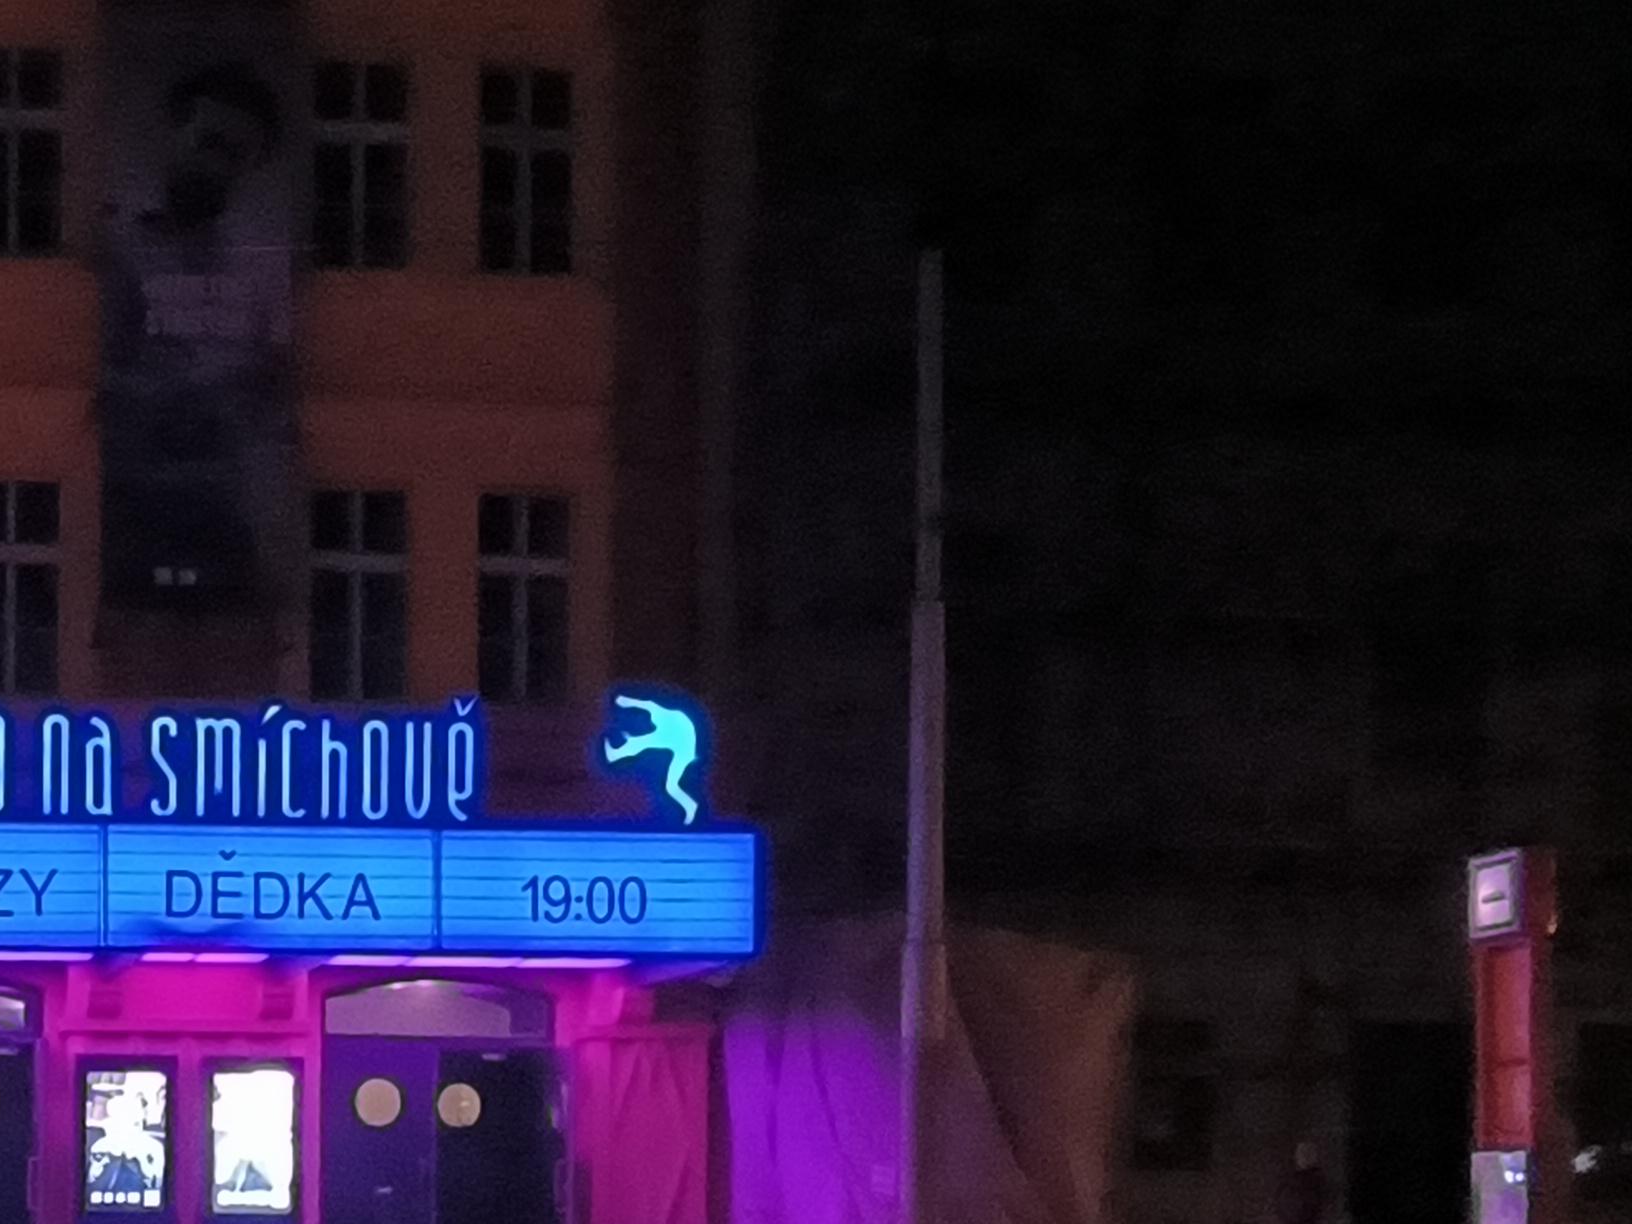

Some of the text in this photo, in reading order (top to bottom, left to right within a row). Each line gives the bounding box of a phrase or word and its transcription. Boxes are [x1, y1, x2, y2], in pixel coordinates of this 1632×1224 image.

[42, 713, 113, 816] na
[164, 850, 382, 921] DĚDKA
[520, 875, 649, 925] 19:00
